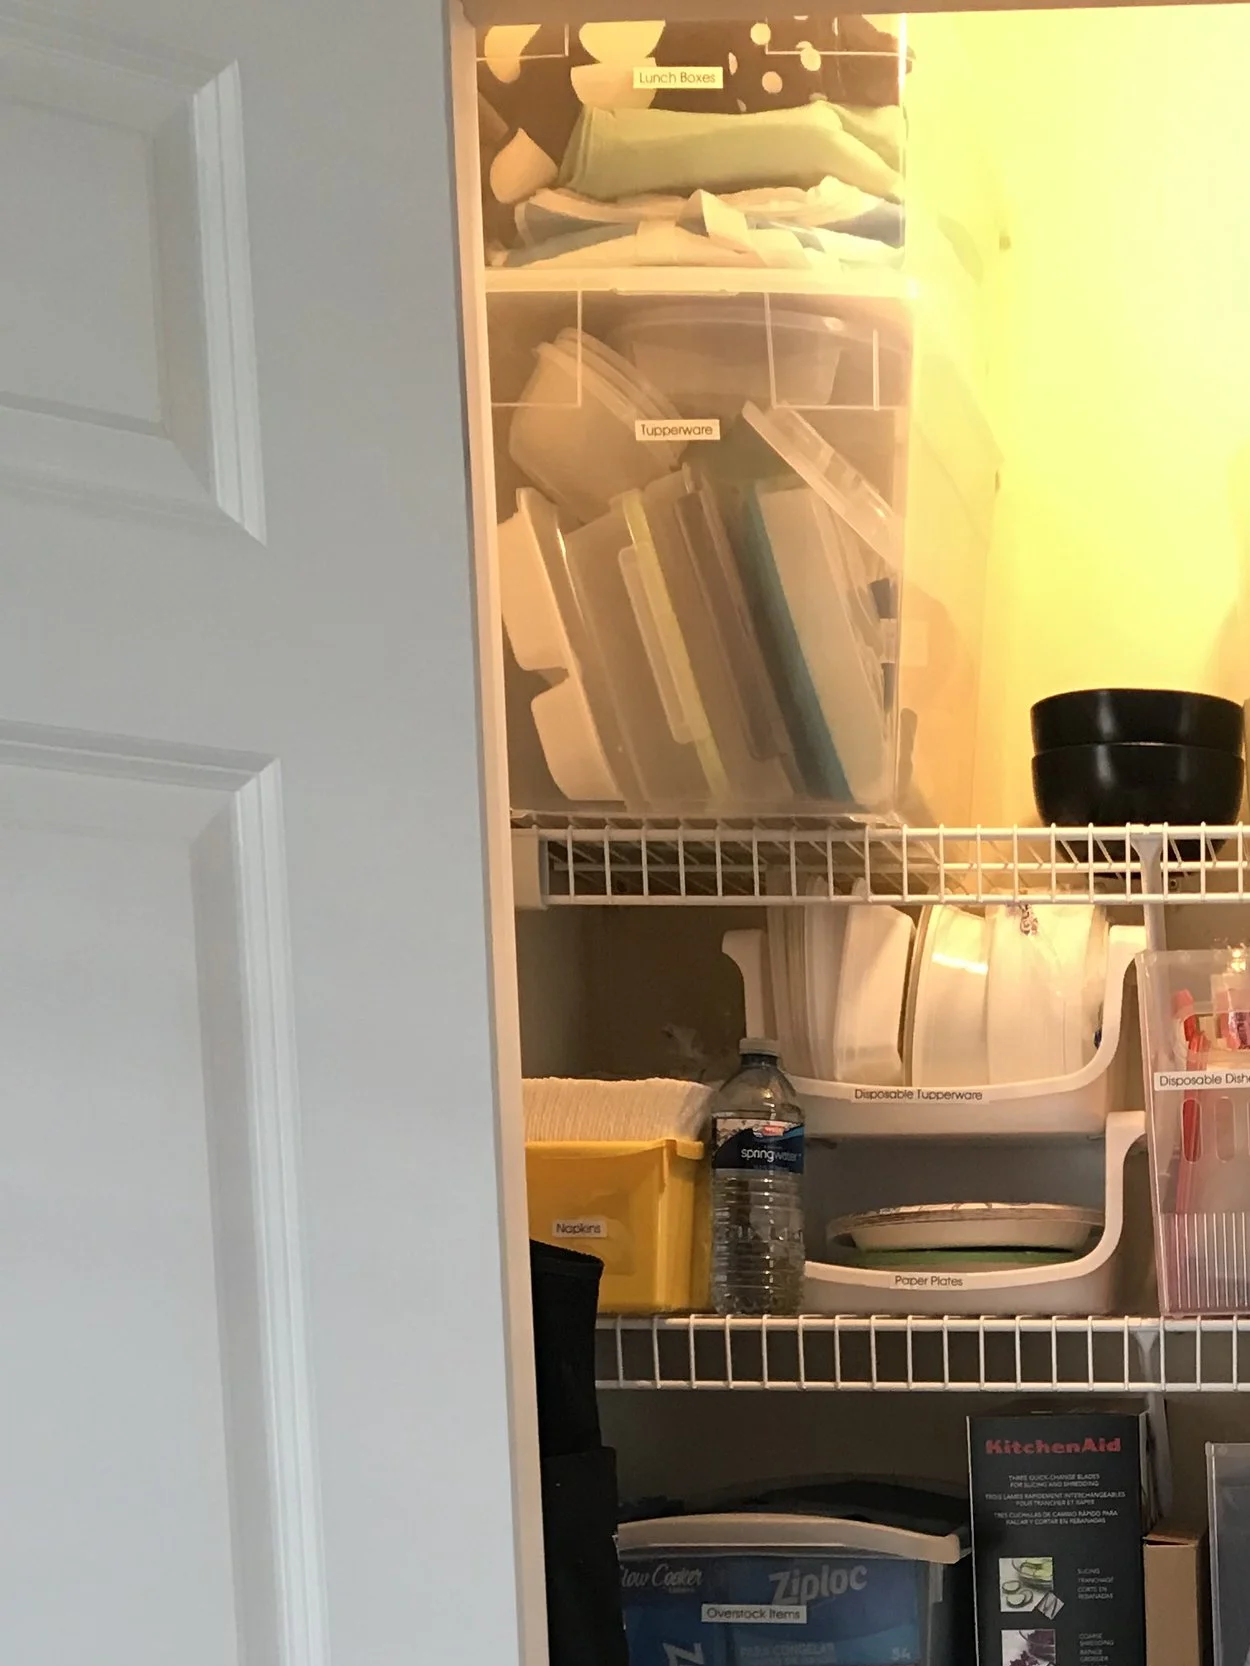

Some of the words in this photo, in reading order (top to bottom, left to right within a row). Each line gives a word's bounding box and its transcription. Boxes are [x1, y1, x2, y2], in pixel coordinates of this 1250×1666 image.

[639, 72, 677, 83] Lunch
[680, 72, 716, 83] Boxes
[641, 424, 713, 437] Tupperware
[1159, 1074, 1222, 1087] Disposable
[854, 1088, 914, 1101] Disposable
[917, 1089, 983, 1101] Tupperware
[556, 1223, 601, 1234] Napkins
[895, 1275, 928, 1286] Paper
[930, 1275, 963, 1286] Plates
[985, 1437, 1121, 1454] KitchenAid
[620, 1565, 649, 1588] low
[651, 1563, 702, 1587] Cooker
[768, 1564, 867, 1604] Ziploc
[706, 1607, 766, 1619] Overstock
[769, 1608, 800, 1619] Items
